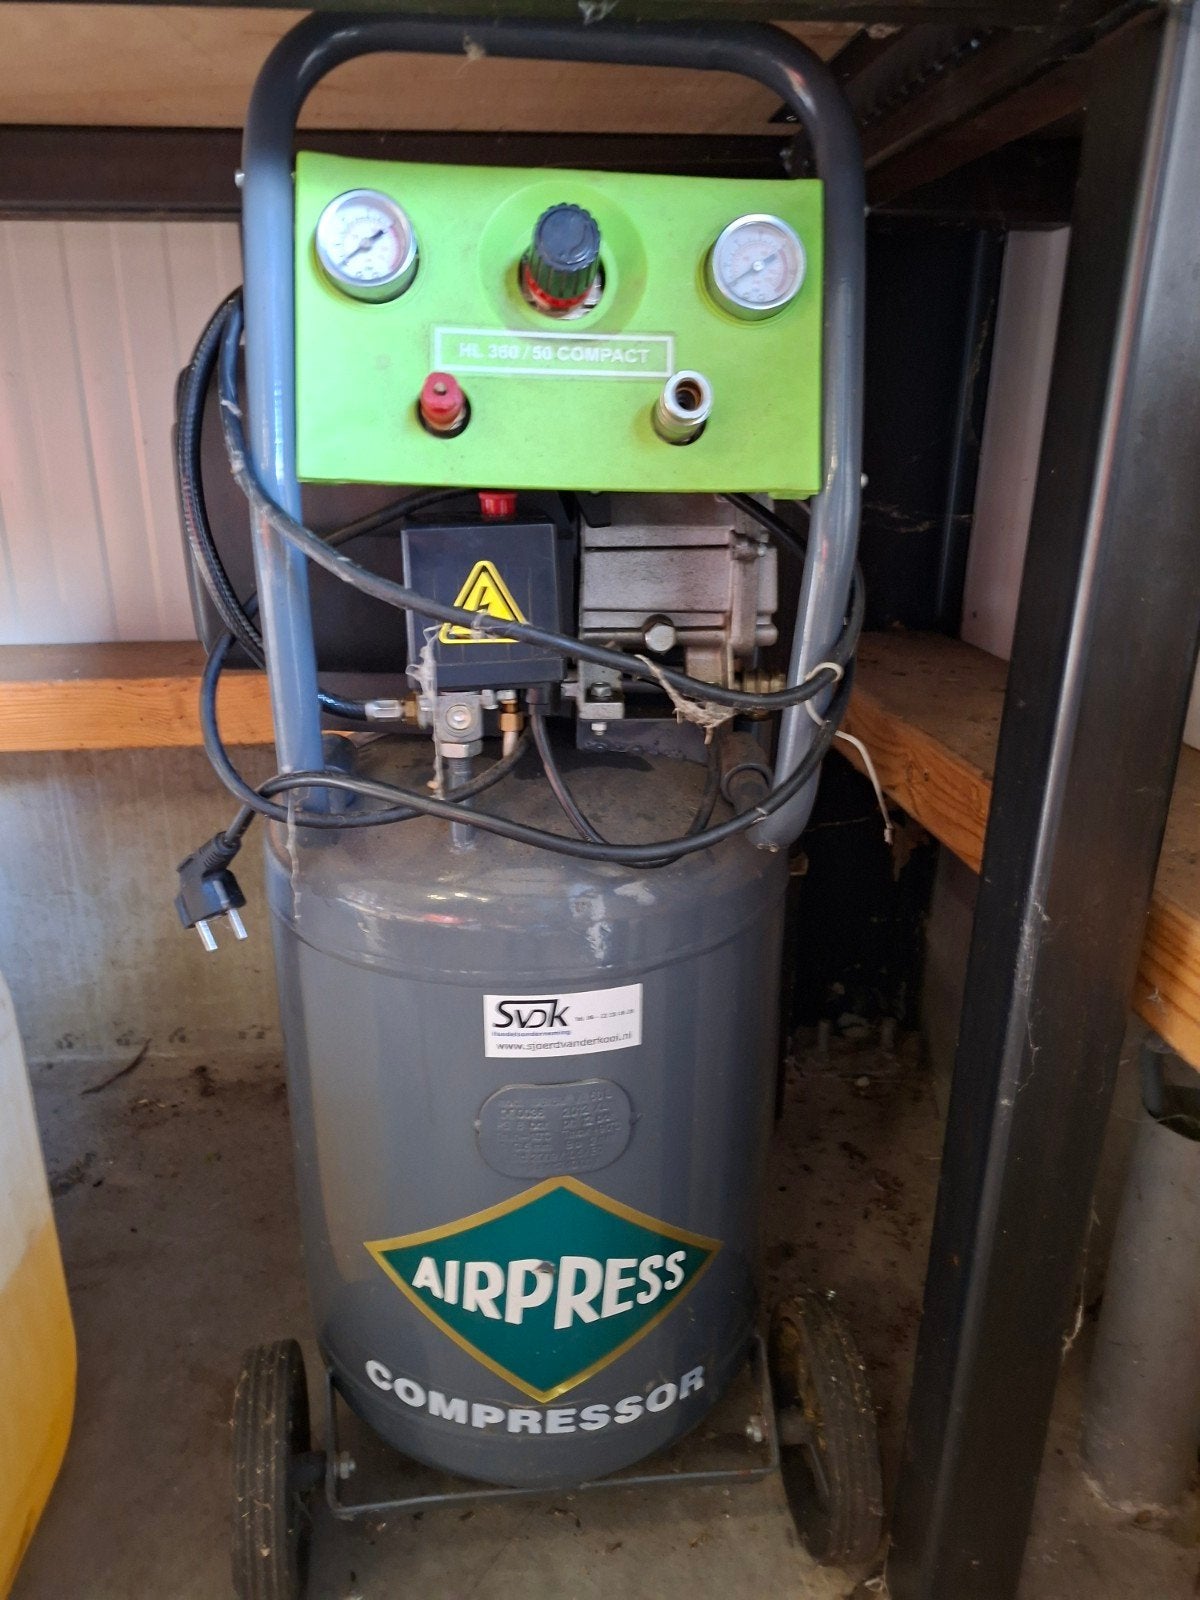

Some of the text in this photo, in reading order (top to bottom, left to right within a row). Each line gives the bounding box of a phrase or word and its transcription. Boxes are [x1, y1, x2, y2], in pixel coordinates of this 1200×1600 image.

[532, 345, 552, 361] 50
[557, 346, 650, 364] COMPACT
[496, 1031, 632, 1051] www.sjoerdvanderkooi.nl
[411, 1250, 687, 1330] AIRPRESS
[365, 1360, 706, 1434] COMPRESSOR
